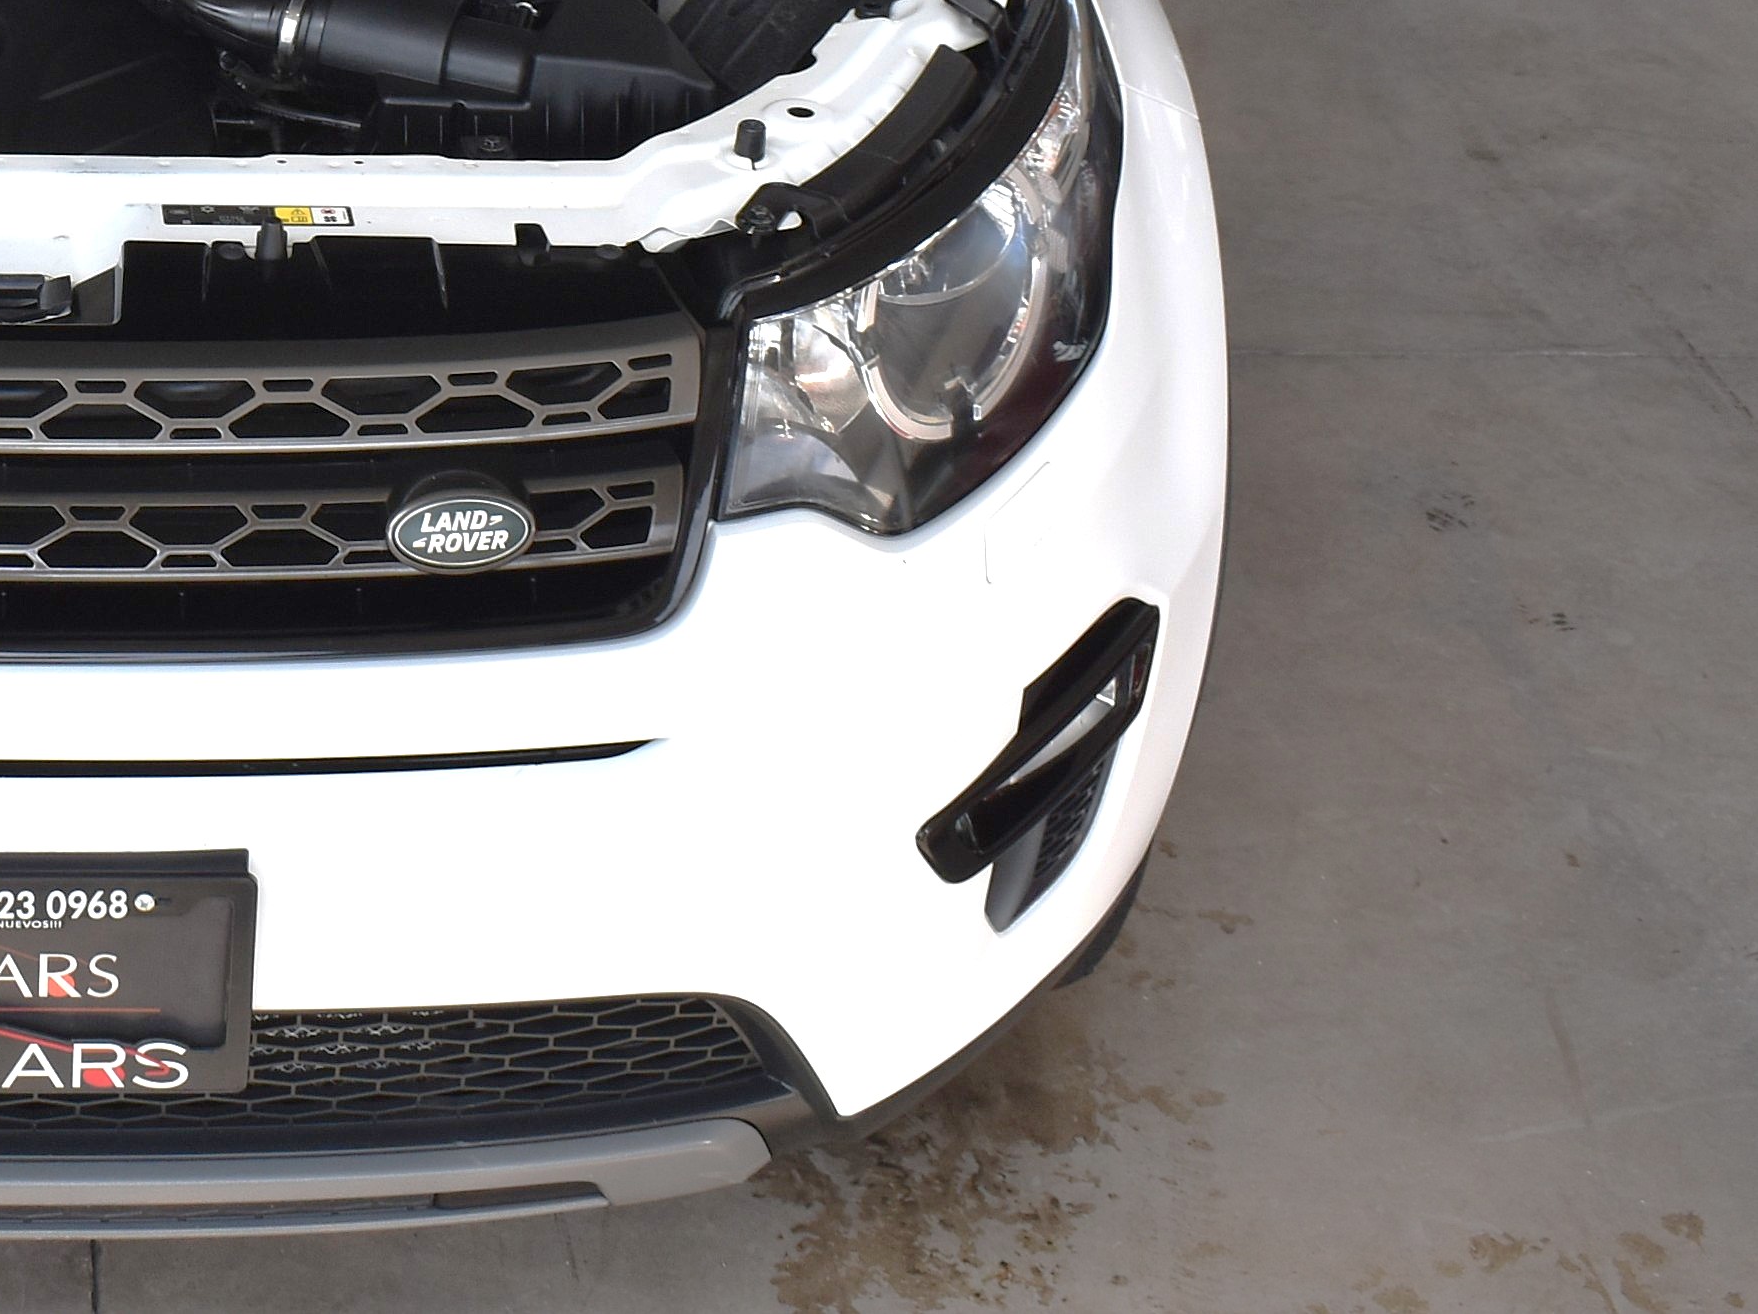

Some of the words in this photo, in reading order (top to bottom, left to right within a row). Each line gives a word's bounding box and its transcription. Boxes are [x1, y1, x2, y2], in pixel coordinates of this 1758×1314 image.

[421, 510, 487, 533] LAND
[427, 529, 509, 554] ROVER
[46, 890, 128, 920] 0968
